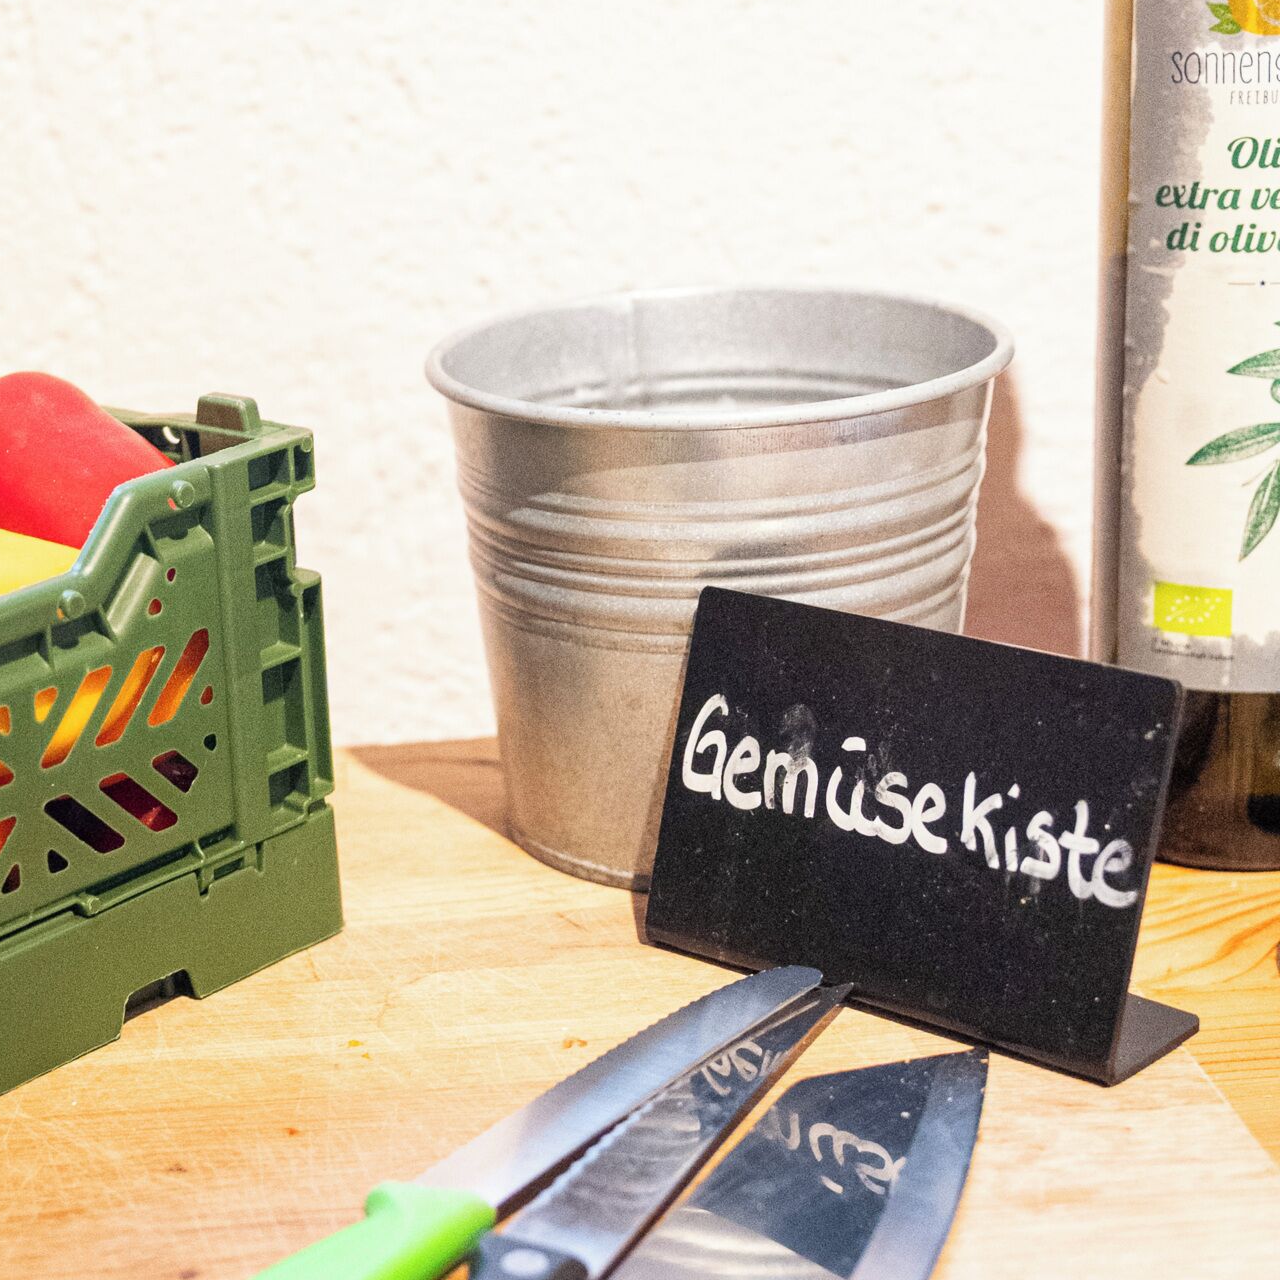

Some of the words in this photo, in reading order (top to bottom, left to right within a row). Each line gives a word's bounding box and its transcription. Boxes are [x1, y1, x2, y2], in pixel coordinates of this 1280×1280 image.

[1155, 181, 1241, 210] extra
[1166, 222, 1202, 251] di
[1209, 223, 1280, 253] oliv
